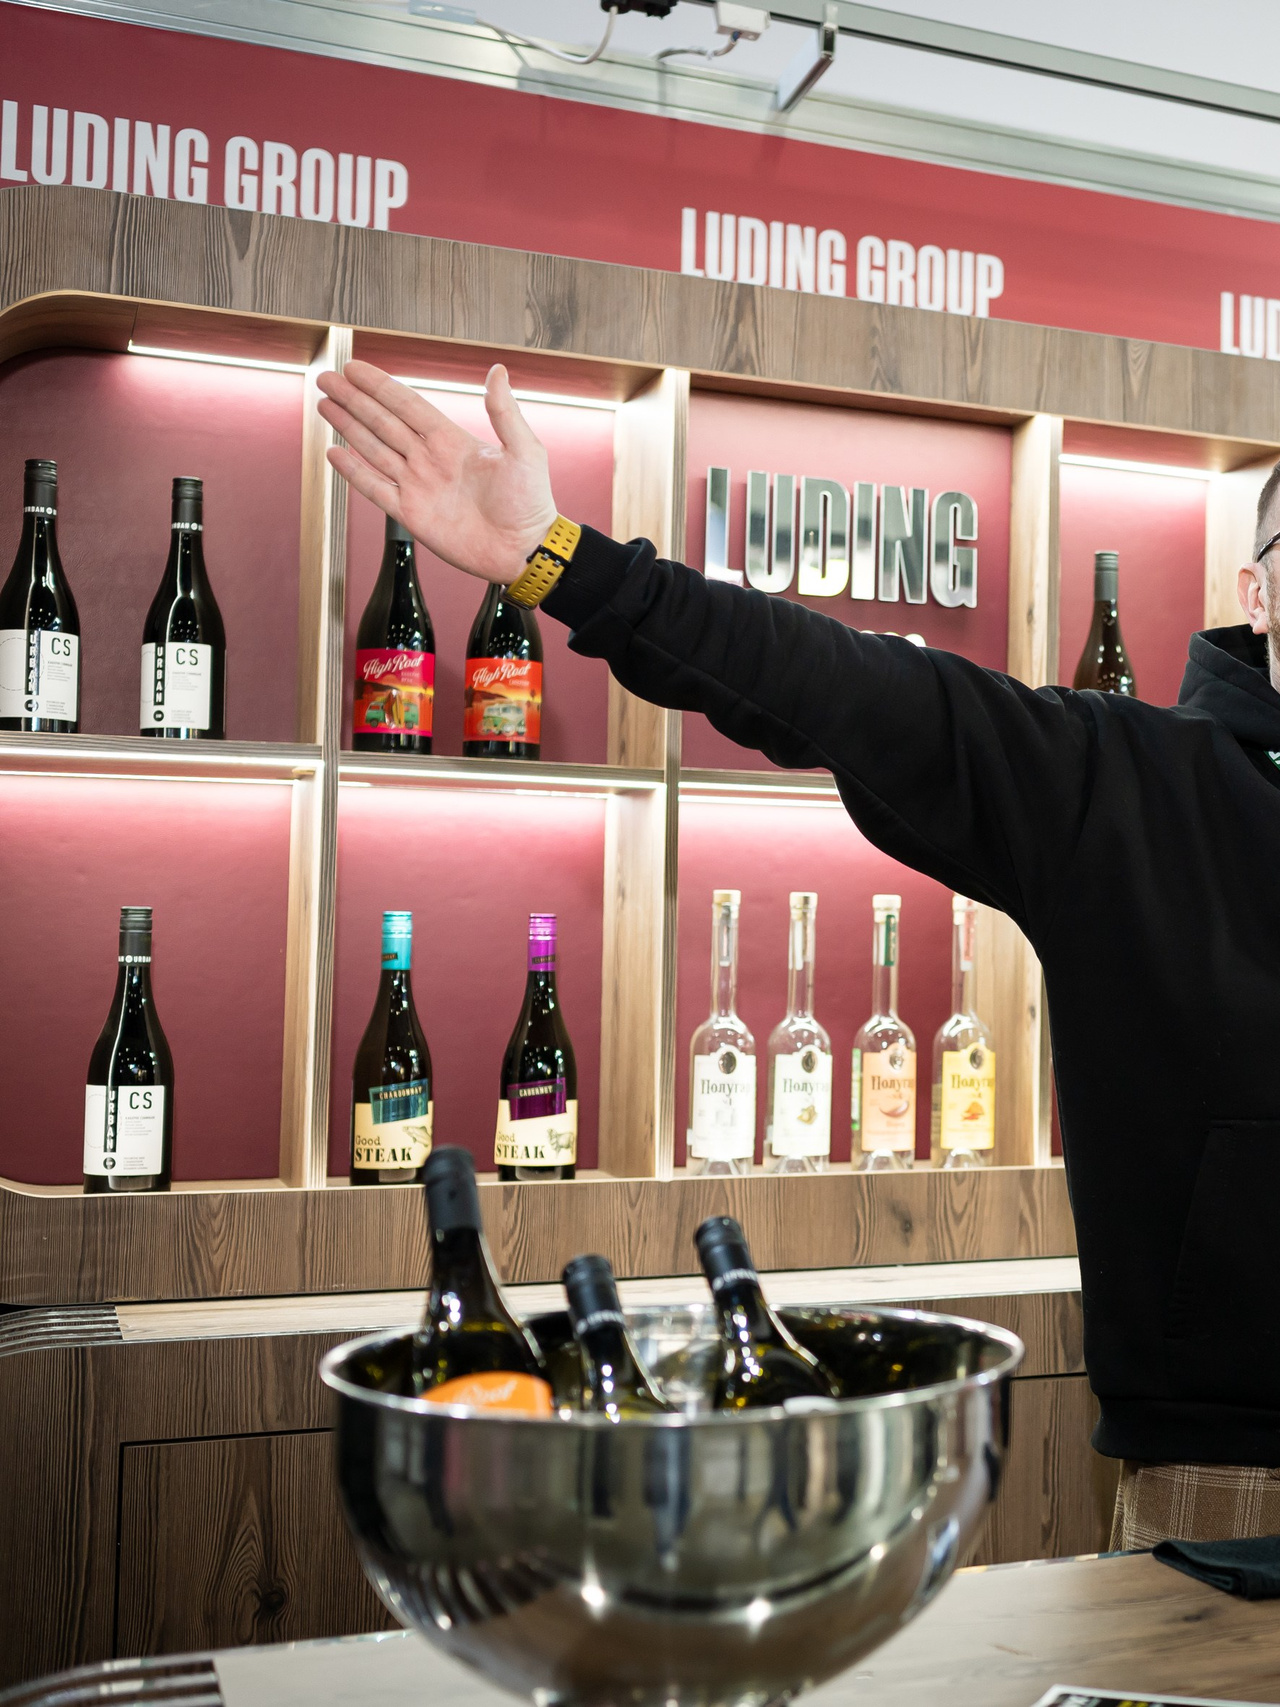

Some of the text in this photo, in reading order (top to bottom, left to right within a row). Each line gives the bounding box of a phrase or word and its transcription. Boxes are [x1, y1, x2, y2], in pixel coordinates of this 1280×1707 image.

[1, 101, 409, 231] LUDING GROUP
[681, 207, 1004, 318] LUDING GROUP
[705, 466, 979, 609] LUDING
[51, 637, 71, 657] CS
[176, 648, 199, 666] CS
[156, 646, 164, 703] URBAN
[363, 659, 392, 680] High
[130, 1092, 152, 1109] CS
[379, 1086, 423, 1100] CHARDONNAY
[519, 1086, 553, 1097] CABERNET
[106, 1090, 115, 1150] URBAN
[355, 1135, 381, 1146] Good
[497, 1131, 516, 1142] Good
[355, 1148, 412, 1162] STEAK
[496, 1146, 545, 1160] STEAK
